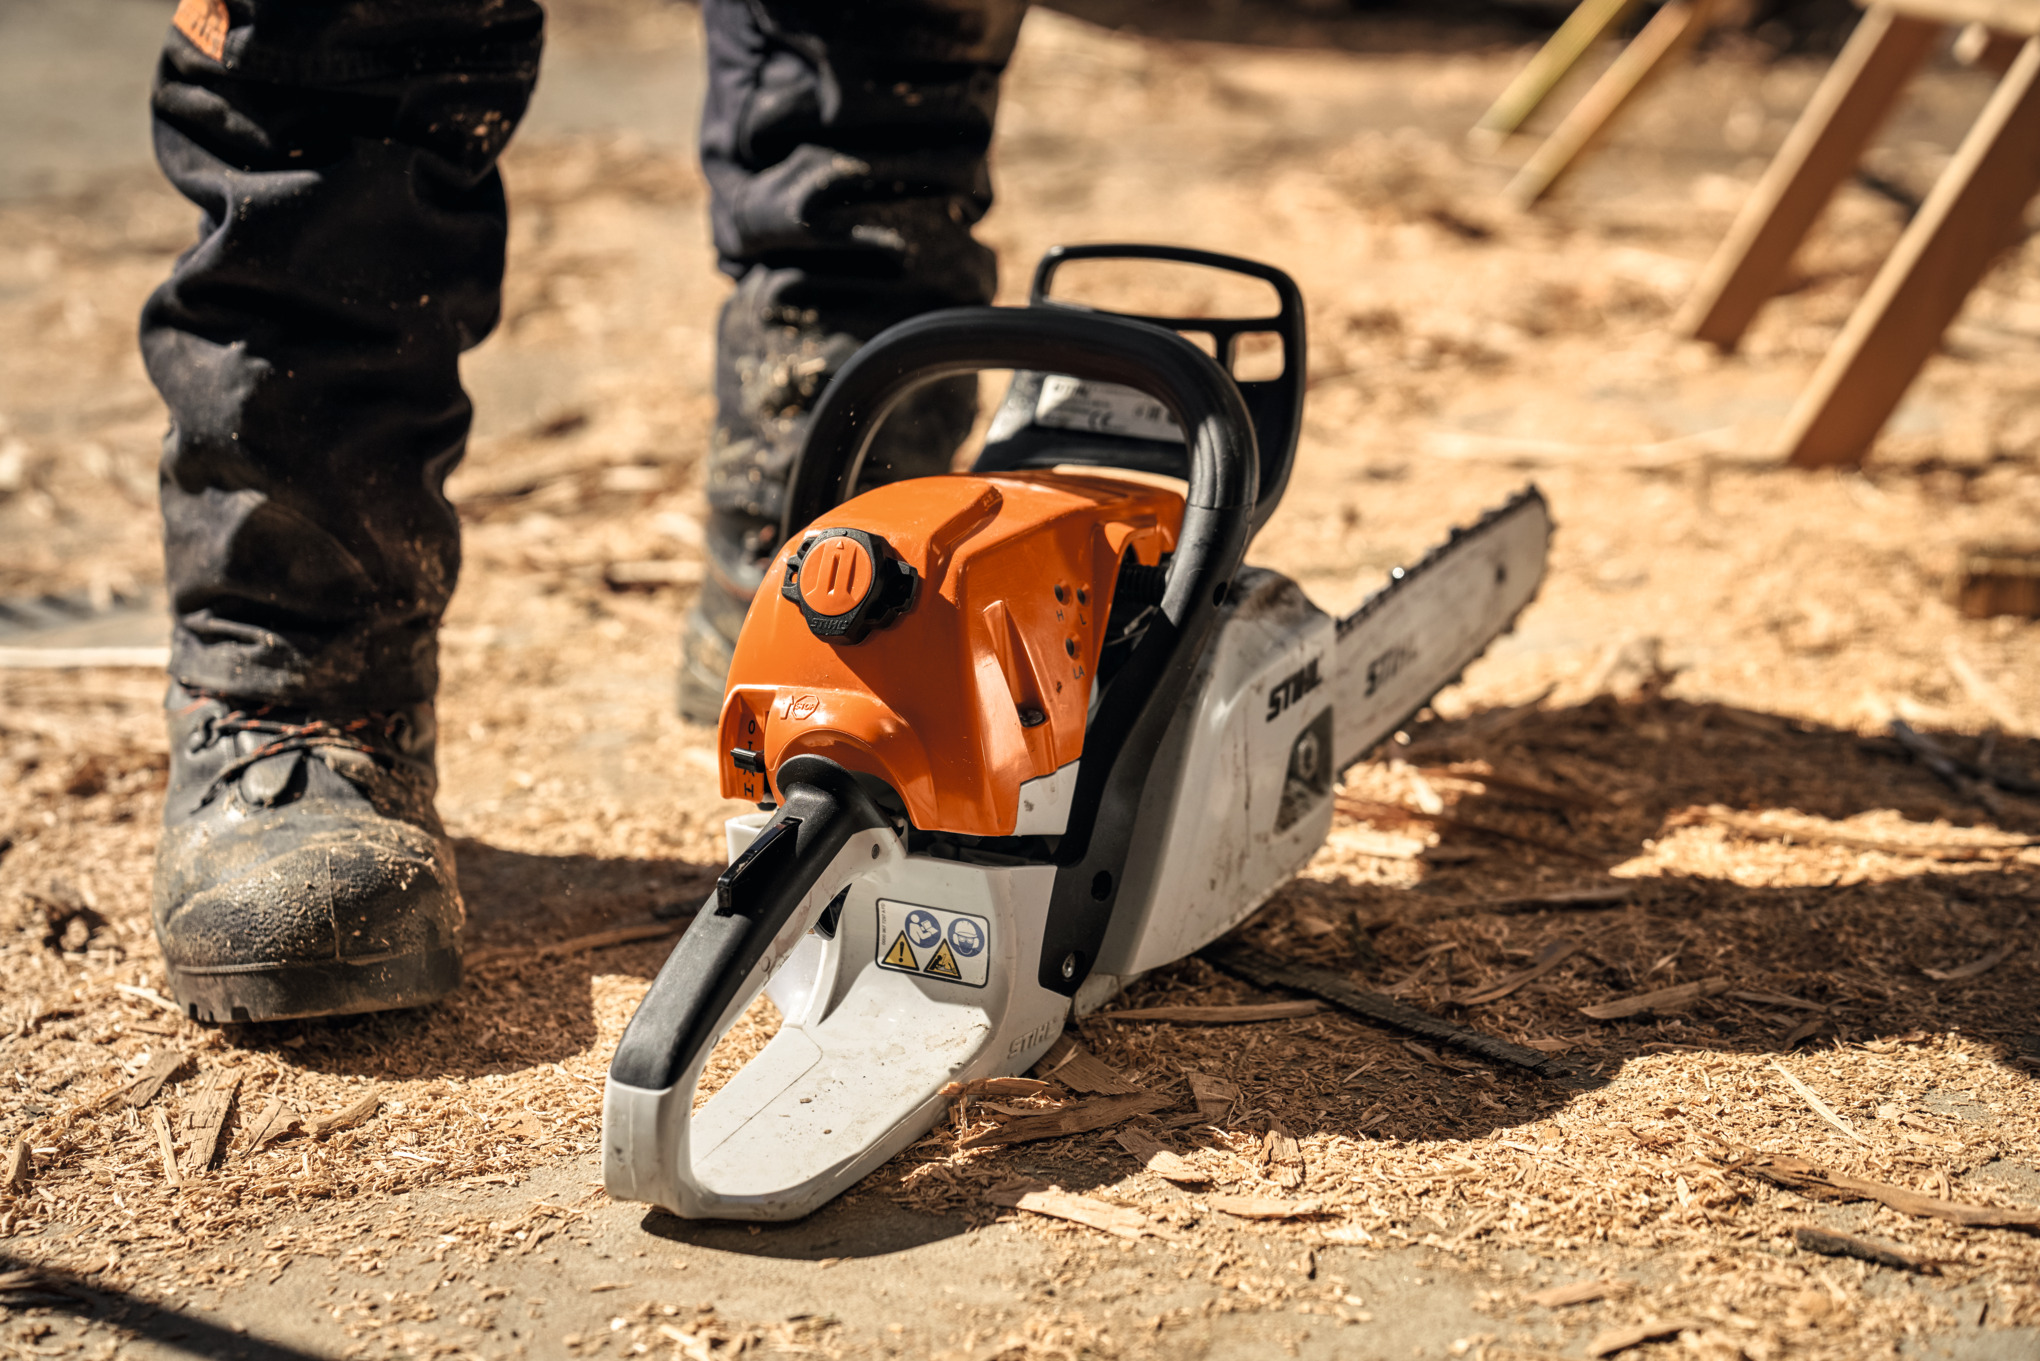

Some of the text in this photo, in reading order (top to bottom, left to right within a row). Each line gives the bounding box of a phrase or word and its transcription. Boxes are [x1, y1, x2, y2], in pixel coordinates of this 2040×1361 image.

[1056, 609, 1064, 622] H
[1079, 613, 1087, 625] L
[1073, 665, 1085, 680] LA
[1266, 656, 1323, 723] STIHL
[795, 702, 815, 712] STOP
[1007, 1019, 1059, 1060] STIHL
